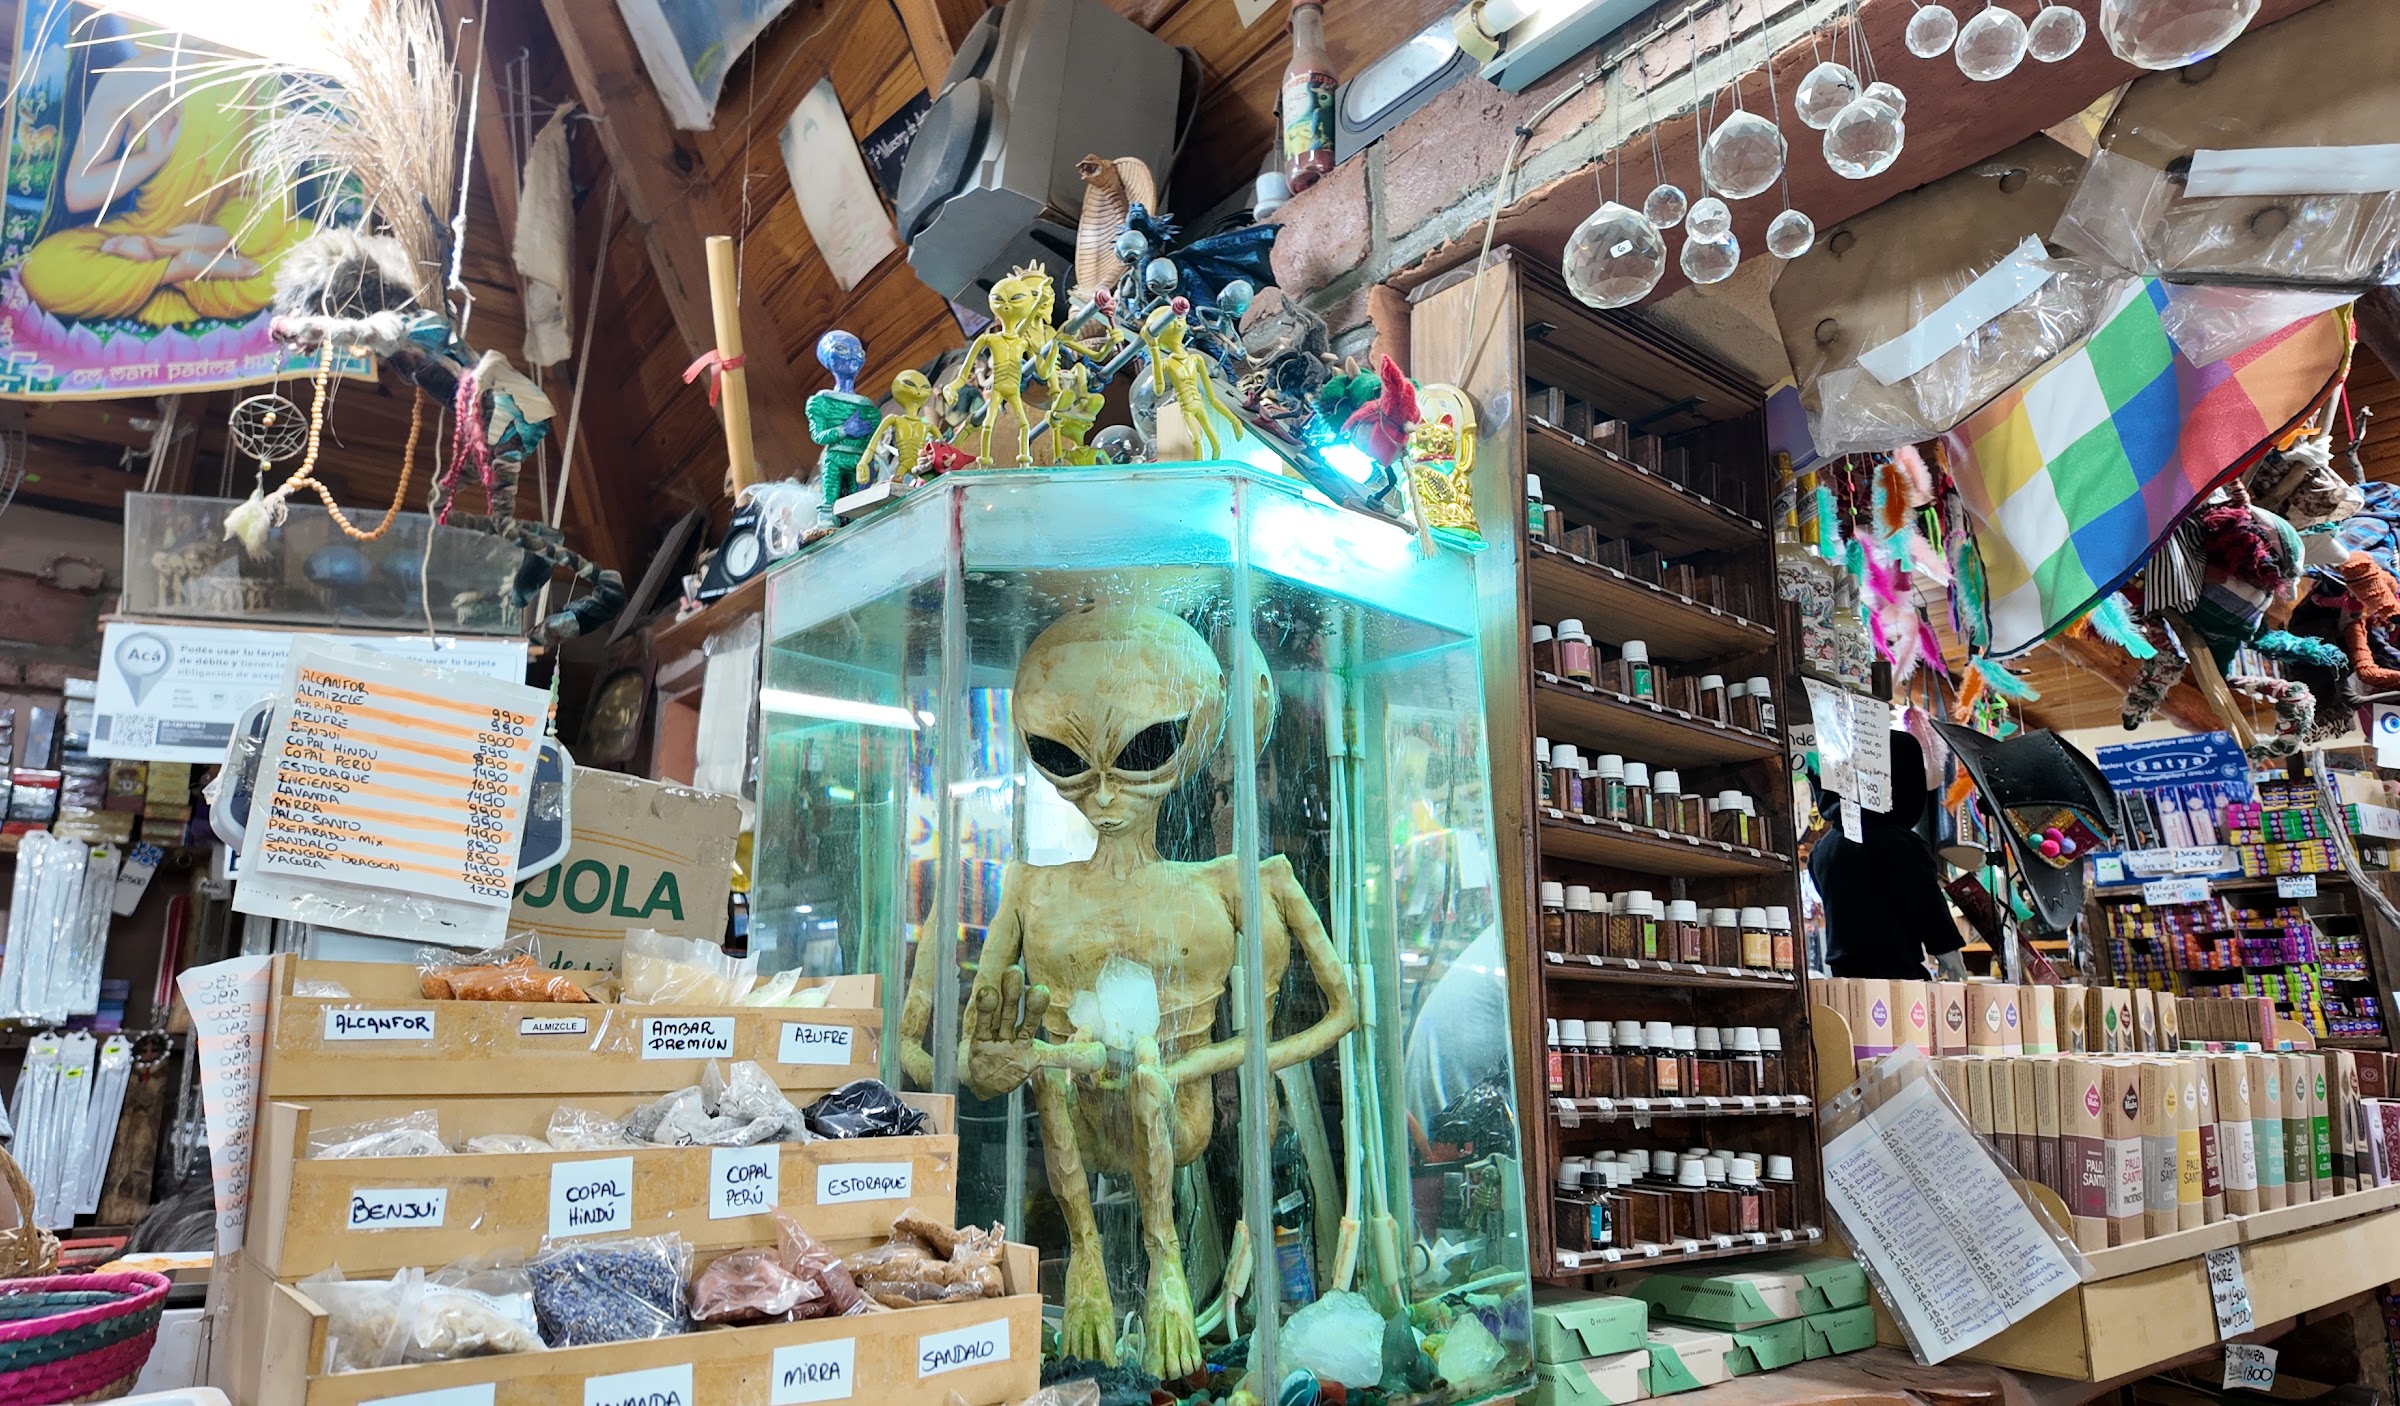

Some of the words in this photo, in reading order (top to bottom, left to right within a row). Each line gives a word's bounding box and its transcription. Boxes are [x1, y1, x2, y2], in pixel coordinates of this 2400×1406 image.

[73, 368, 104, 385] om
[110, 363, 160, 381] mani
[167, 358, 238, 381] padma
[128, 648, 161, 662] Acá
[195, 657, 229, 667] débito
[217, 648, 240, 656] usar
[302, 670, 368, 695] ALCANFOR
[492, 709, 524, 724] 990
[298, 684, 364, 705] ALMIZCLE
[491, 721, 523, 736] 990
[294, 709, 348, 729] AZUFRE
[479, 746, 508, 759] 590
[477, 733, 515, 748] 5900
[286, 735, 326, 751] COPAL
[473, 766, 508, 783] 1490
[2137, 757, 2203, 772] Satya
[285, 746, 325, 763] COPAL
[336, 756, 371, 771] PERU
[472, 780, 507, 796] 1690
[279, 760, 370, 784] ESTORAQUE
[467, 791, 506, 808] 1490
[277, 783, 340, 804] LAVANDA
[471, 816, 503, 831] 990
[469, 803, 501, 818] 990
[271, 806, 304, 823] PALO
[312, 815, 361, 831] SANTO
[467, 840, 498, 855] 890
[464, 827, 502, 844] 1490
[269, 820, 346, 842] PREPARADO
[467, 852, 500, 866] 890
[266, 834, 338, 851] SANDALO
[464, 863, 504, 878] 1490
[266, 844, 333, 860] SANGRE
[342, 854, 400, 871] DRAGON
[462, 874, 506, 888] 2900
[470, 885, 509, 898] 1200
[335, 1014, 430, 1032] ALCANFOR
[532, 1021, 578, 1031] ALMIZCLE
[652, 1020, 715, 1036] AMBAR
[795, 1026, 848, 1046] AZUFRE
[1840, 1146, 1870, 1172] AZAHAR
[1931, 1143, 1960, 1166] OPIUM
[2125, 1157, 2140, 1171] PALO
[727, 1162, 773, 1182] COPAL
[1942, 1163, 1968, 1183] PINO
[2086, 1160, 2104, 1174] PALO
[828, 1176, 906, 1196] ESTORAQUE
[1955, 1175, 1988, 1200] POMELO
[2083, 1173, 2105, 1187] SANTO
[2123, 1170, 2142, 1185] SANTO
[567, 1182, 625, 1202] COPAL
[727, 1184, 763, 1207] PERÚ
[1874, 1191, 1895, 1208] COCO
[1898, 1219, 1925, 1241] FRESIA
[1944, 1285, 1976, 1309] LIMON
[922, 1340, 994, 1372] SANDALO
[784, 1362, 840, 1387] MIRRA
[2244, 1365, 2273, 1381] 1800
